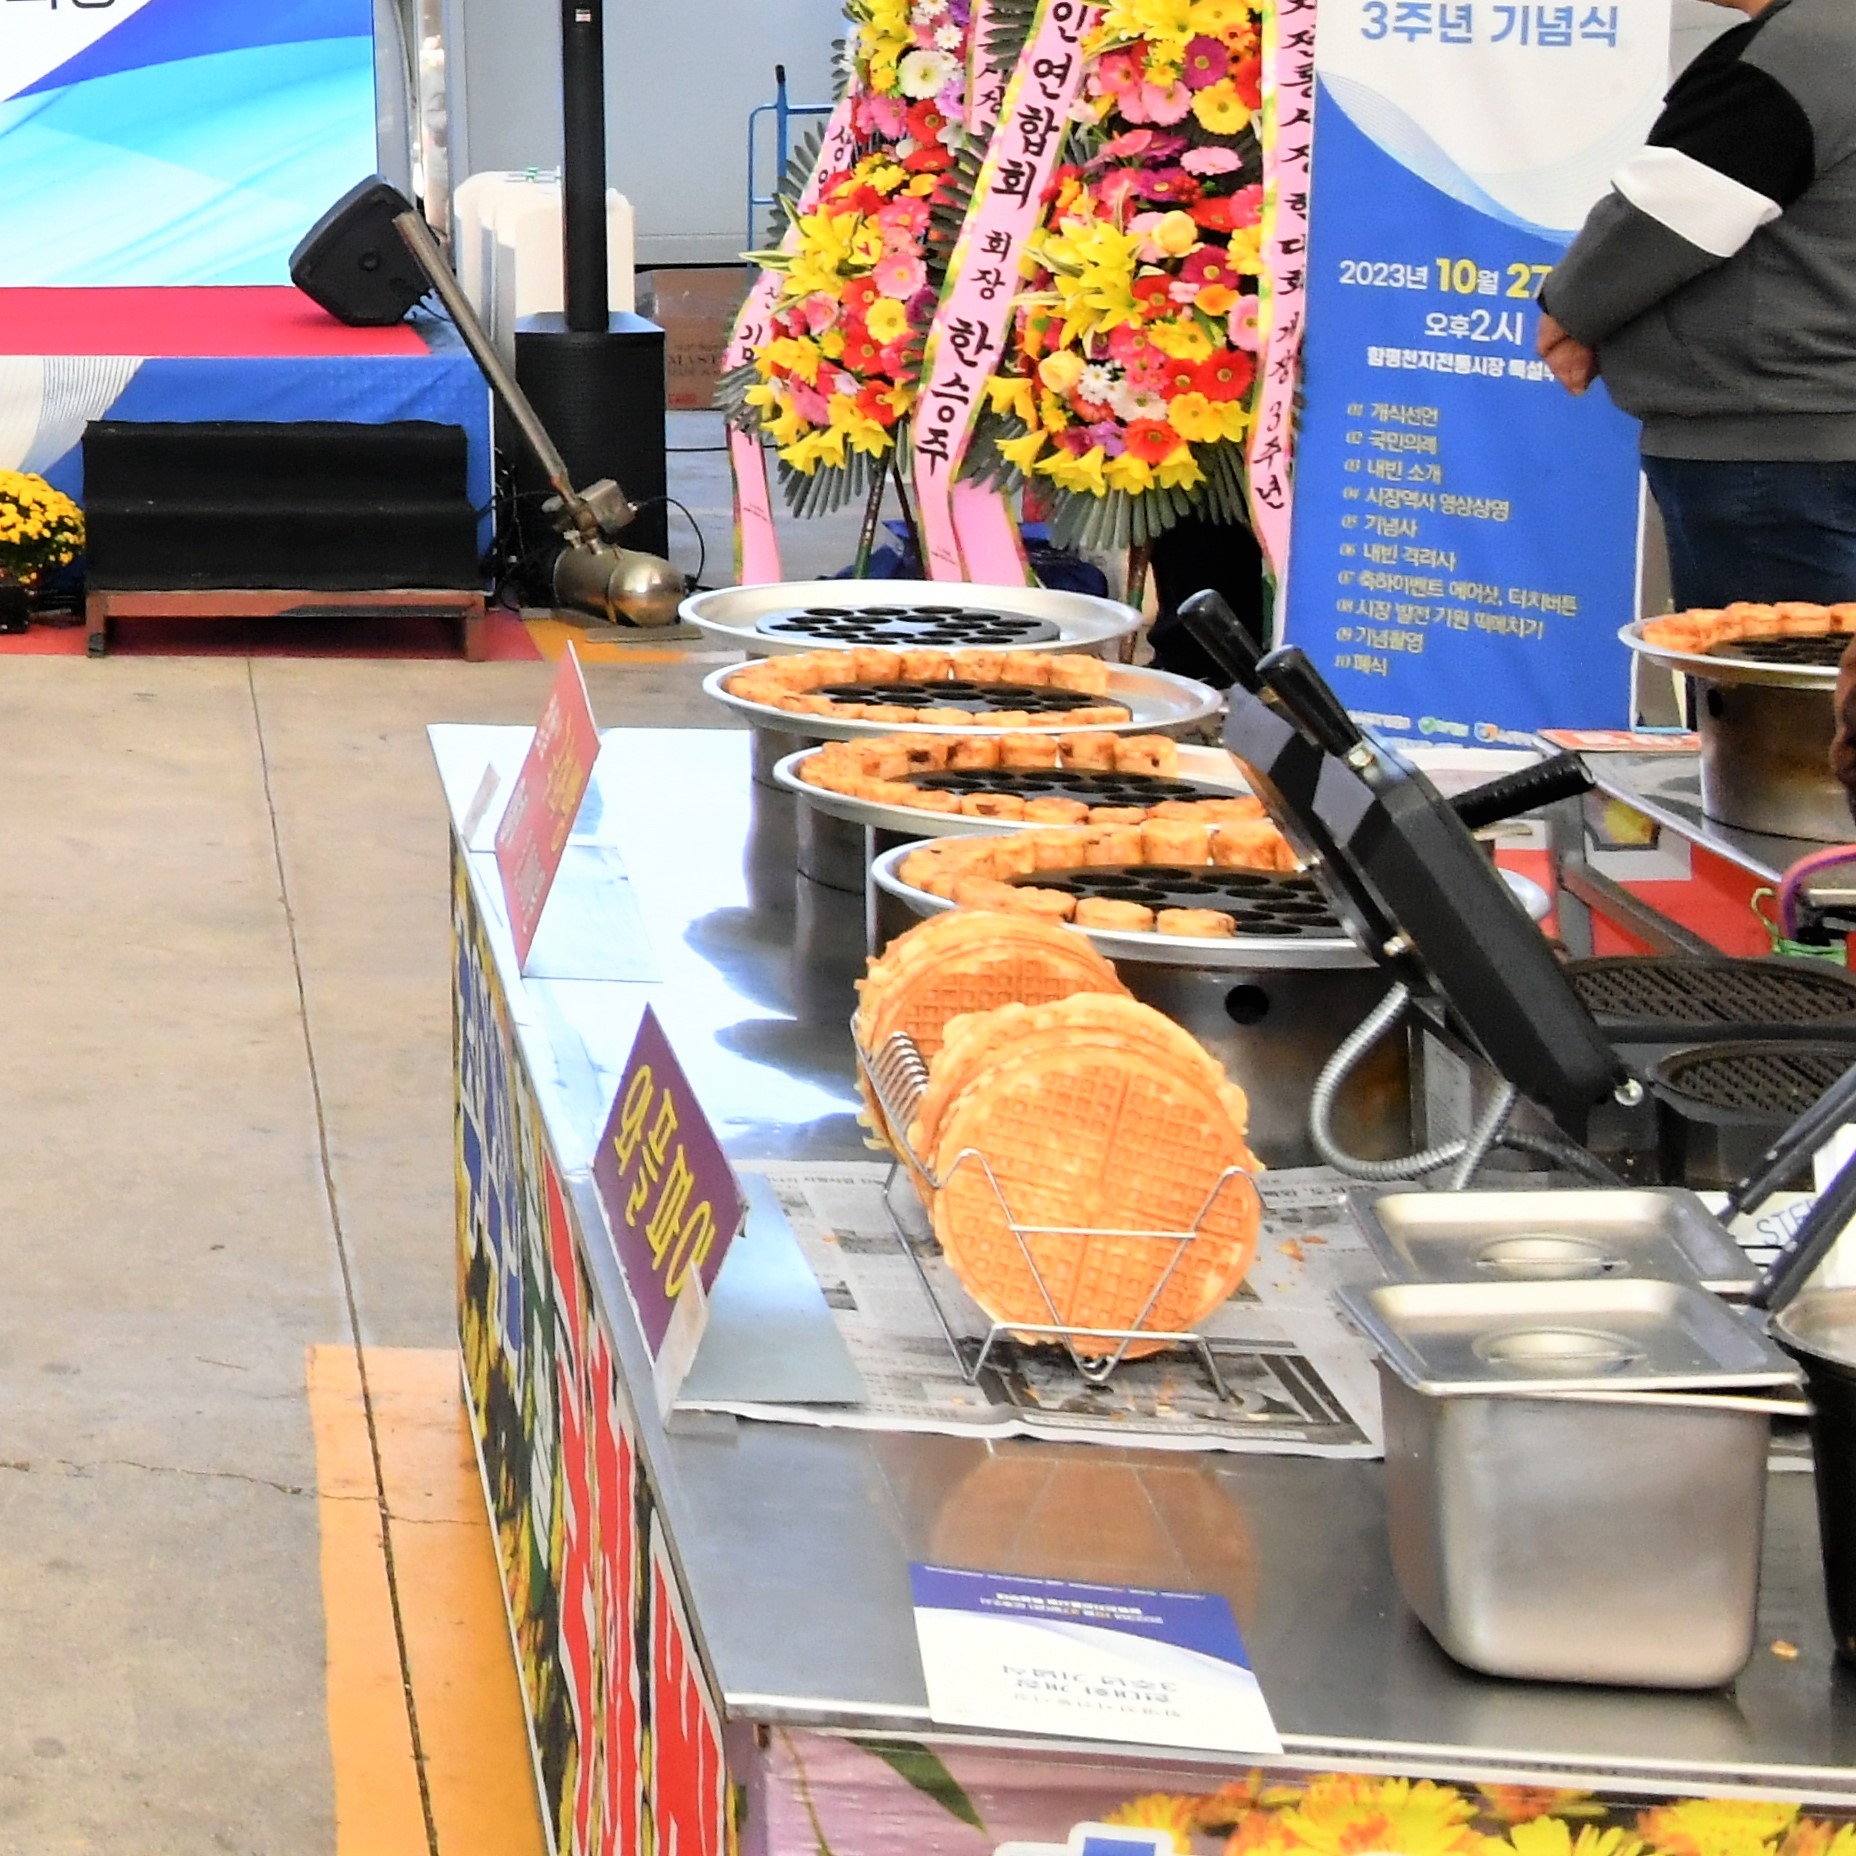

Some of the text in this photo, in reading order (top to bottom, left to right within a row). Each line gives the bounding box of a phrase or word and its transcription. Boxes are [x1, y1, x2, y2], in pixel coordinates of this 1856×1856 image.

[1360, 0, 1620, 49] 3주년 기념식
[971, 229, 1014, 301] 회장
[1339, 259, 1429, 291] 2023년
[1436, 257, 1500, 297] 10월
[1366, 344, 1505, 378] 함평천지전통시장
[916, 317, 995, 477] 한승주
[1370, 402, 1440, 427] 개식선언
[1407, 462, 1443, 485] 소개
[1364, 513, 1420, 539] 기념사
[613, 1063, 717, 1299] 와플파이
